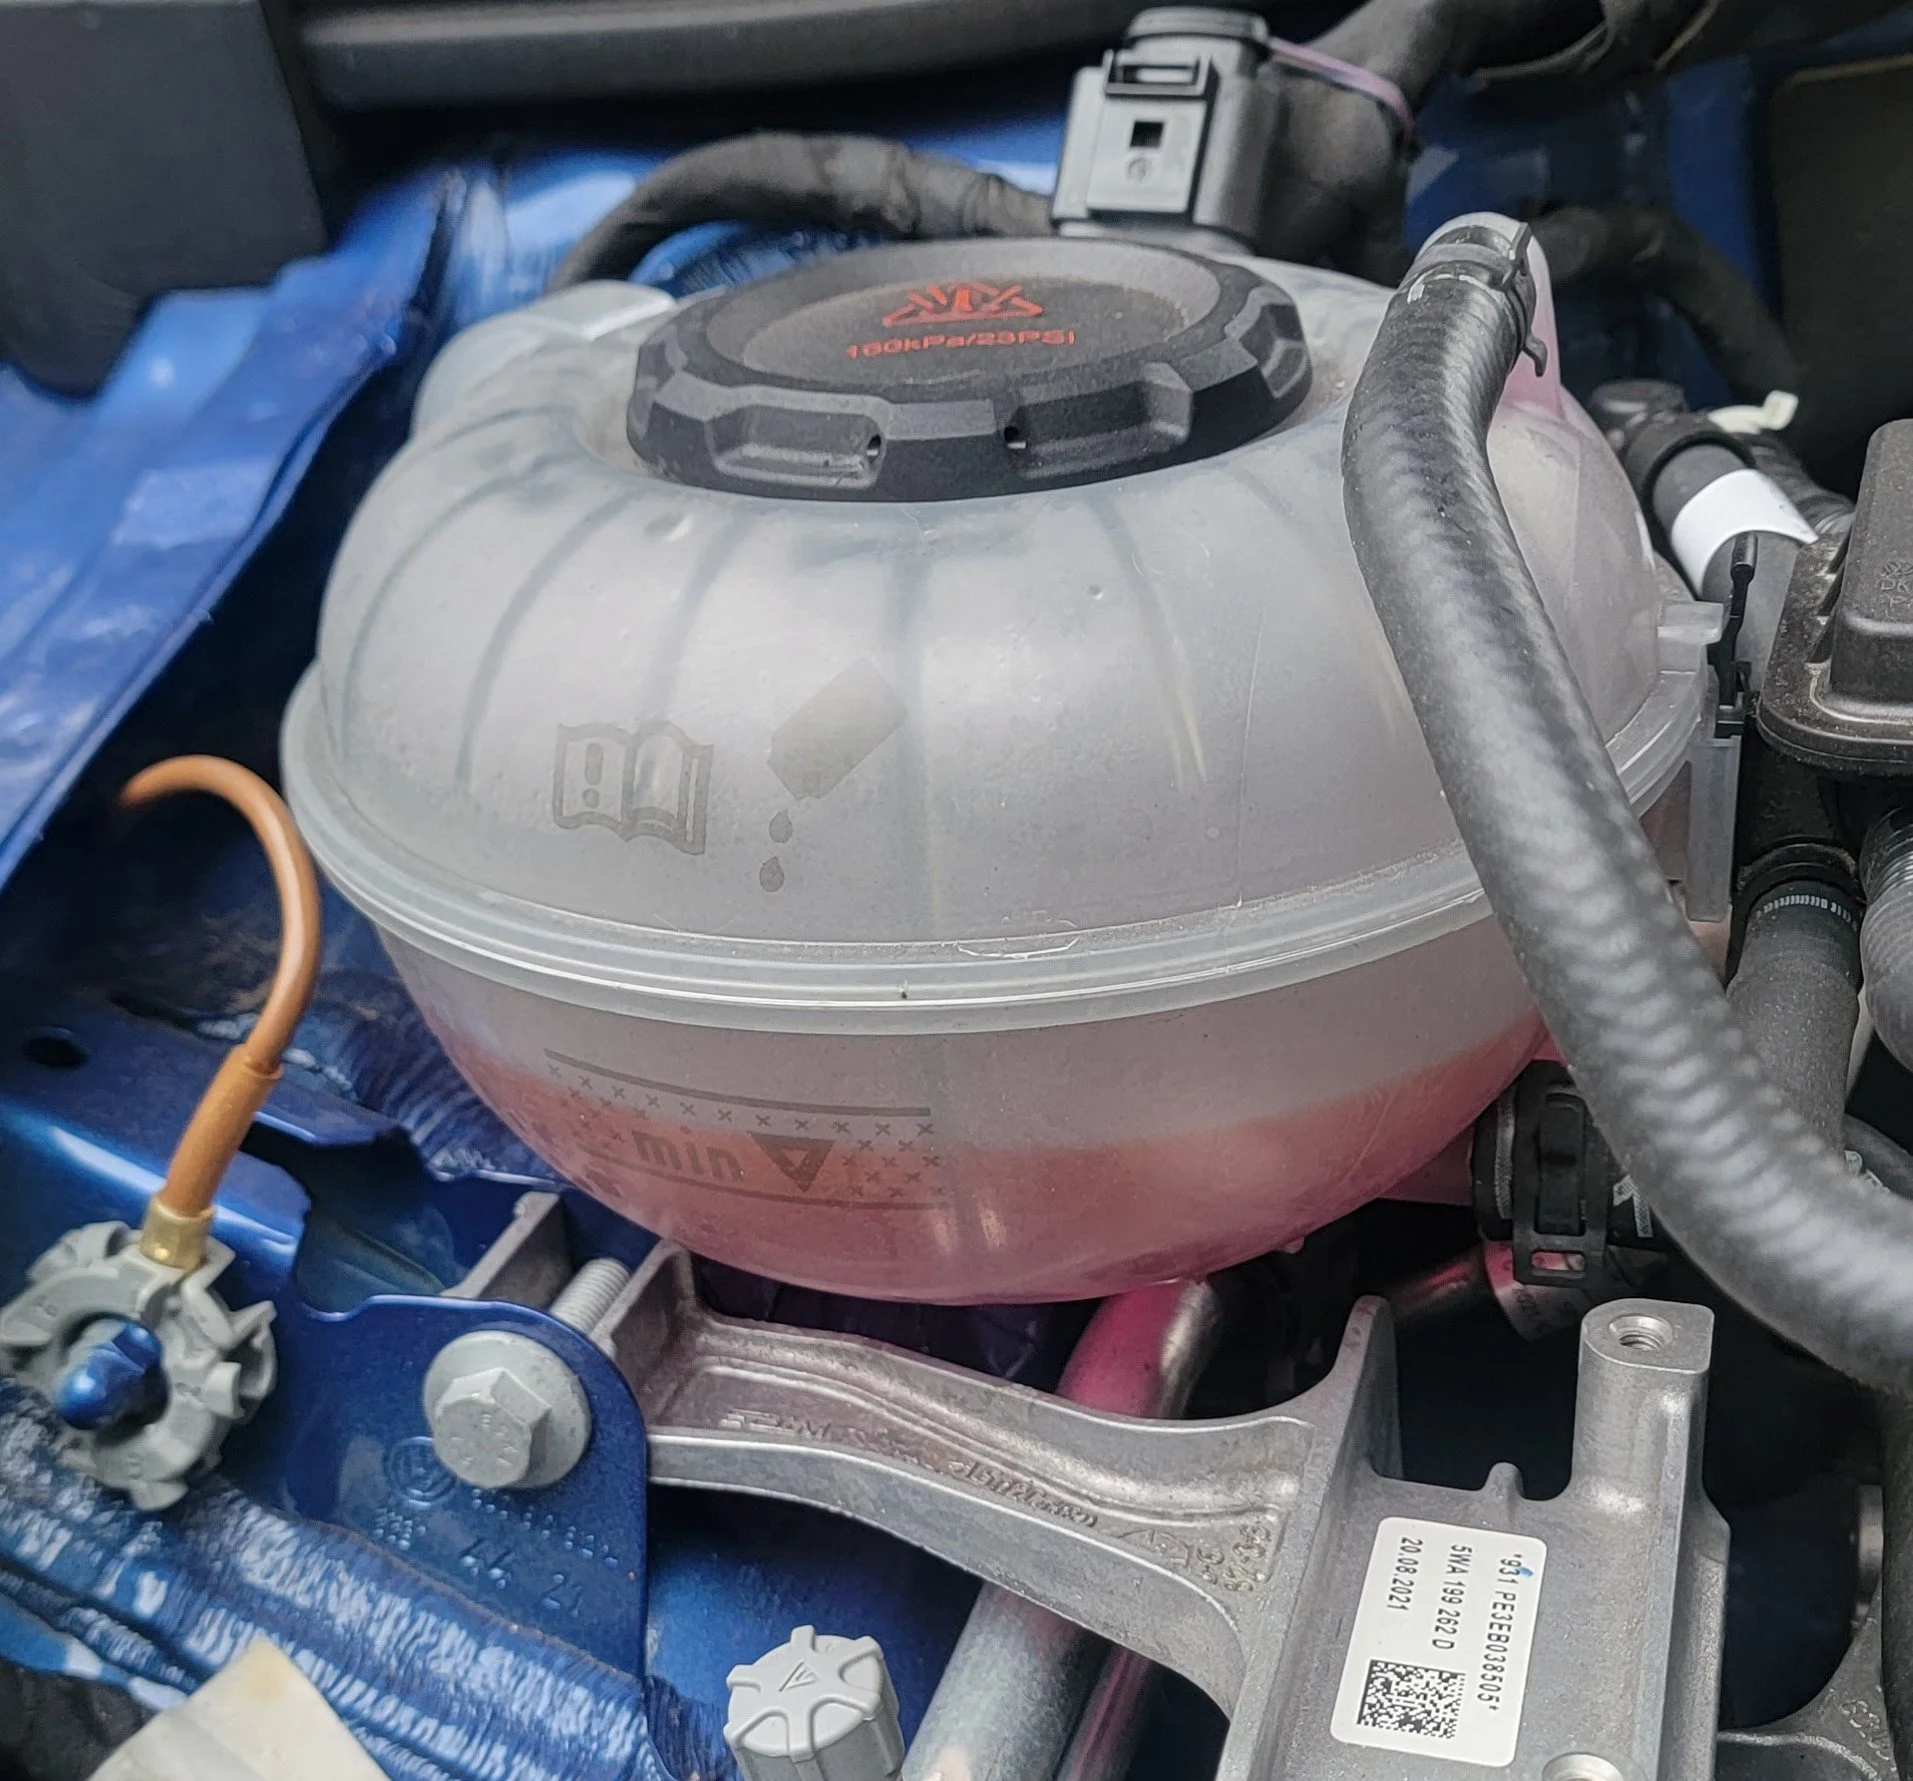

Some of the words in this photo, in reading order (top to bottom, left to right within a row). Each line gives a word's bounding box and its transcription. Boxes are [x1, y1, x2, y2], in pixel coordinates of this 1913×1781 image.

[632, 1125, 743, 1182] min
[1386, 1536, 1424, 1612] 20.08.2021
[1448, 1544, 1473, 1575] 5WA
[1441, 1580, 1466, 1605] 199
[1435, 1608, 1461, 1636] 262
[1432, 1639, 1455, 1651] D
